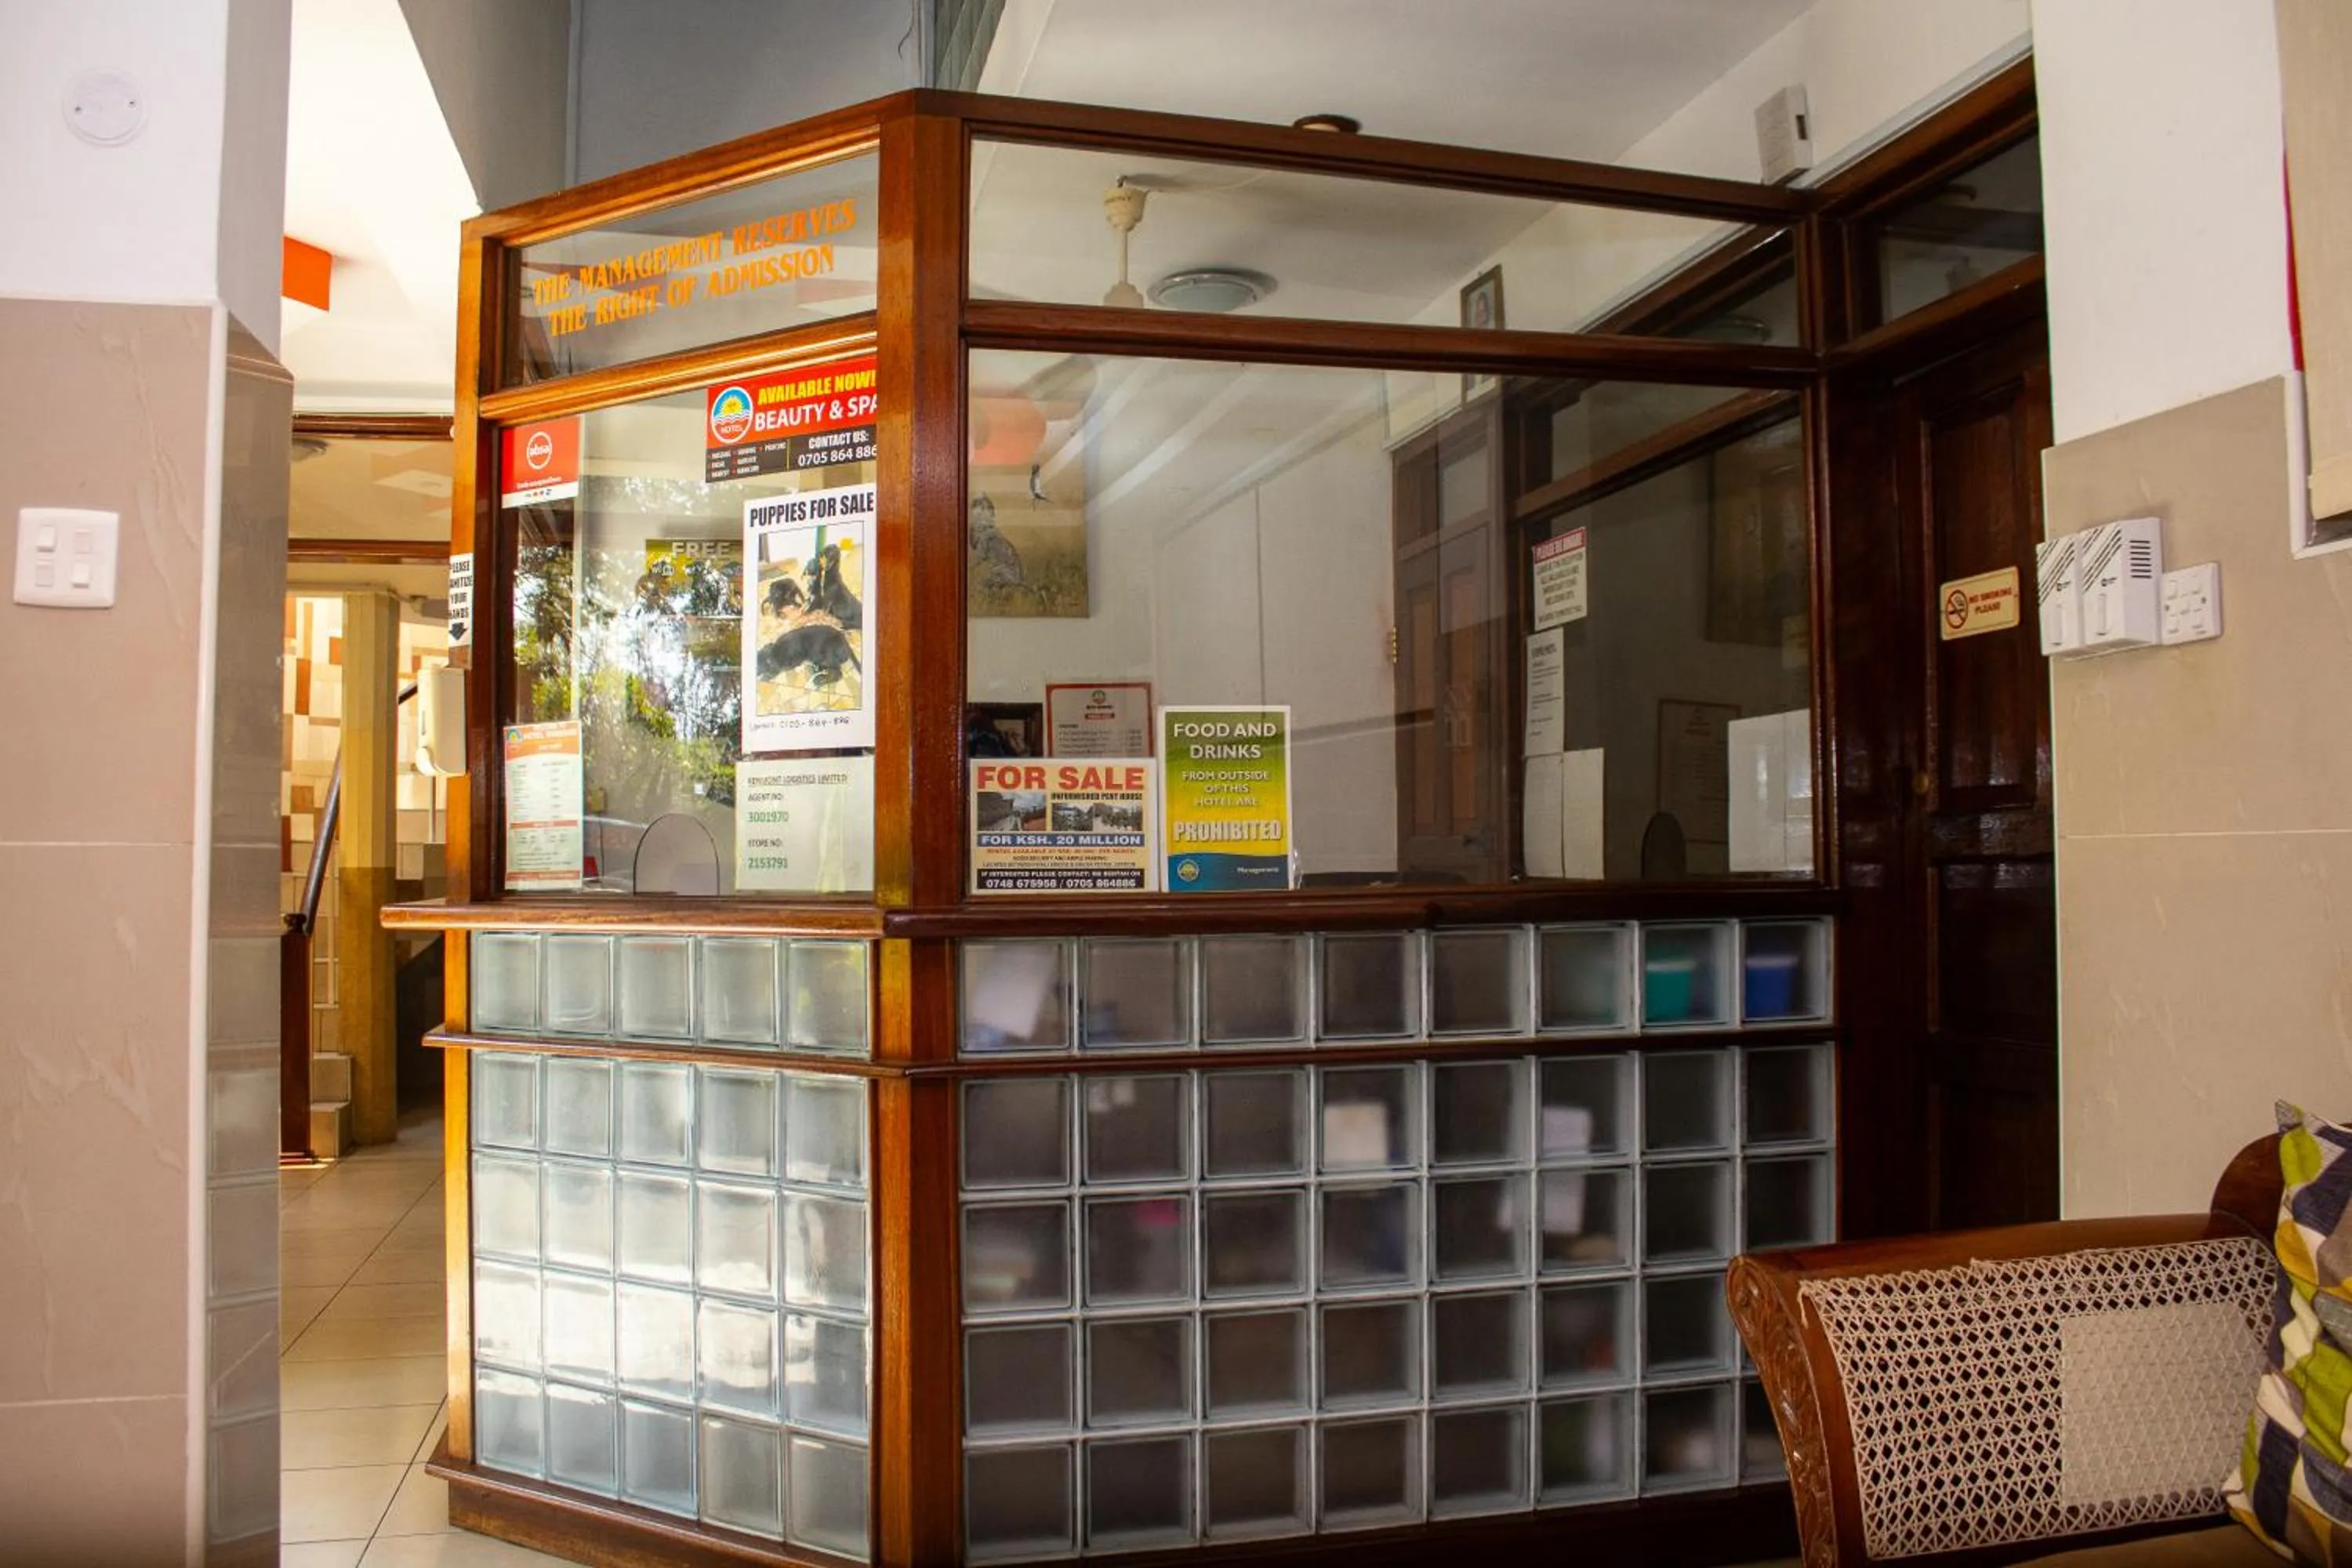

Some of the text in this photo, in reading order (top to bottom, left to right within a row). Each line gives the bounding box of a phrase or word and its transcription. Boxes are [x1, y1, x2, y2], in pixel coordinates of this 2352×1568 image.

[533, 198, 858, 306] THE MANAGEMENT RESERVES
[549, 243, 835, 336] THE RIGHT OF ADMISSION
[757, 369, 877, 405] AVAILABLE NOW!
[755, 401, 826, 431] BEAUTY
[829, 399, 844, 420] &
[808, 434, 851, 448] CONTACT
[797, 452, 828, 467] 0705
[830, 448, 853, 463] 864
[750, 492, 874, 528] PUPPIES FOR SALE
[672, 542, 730, 560] FREE
[1980, 587, 2012, 601] SMOKING
[1975, 601, 2000, 615] PLEASE
[1174, 723, 1277, 738] FOOD AND
[1190, 744, 1262, 760] DRINKS
[818, 773, 848, 783] LIMITED
[977, 765, 1145, 791] FOR SALE
[1181, 771, 1269, 781] FROM OUTSIDE
[1204, 783, 1250, 793] OF THIS
[748, 793, 770, 801] AGENT
[1173, 819, 1282, 842] PROHIBITED
[748, 839, 768, 848] STORE
[980, 833, 1142, 845] FOR KSH. 20 MILLION
[1065, 878, 1094, 888] 0705
